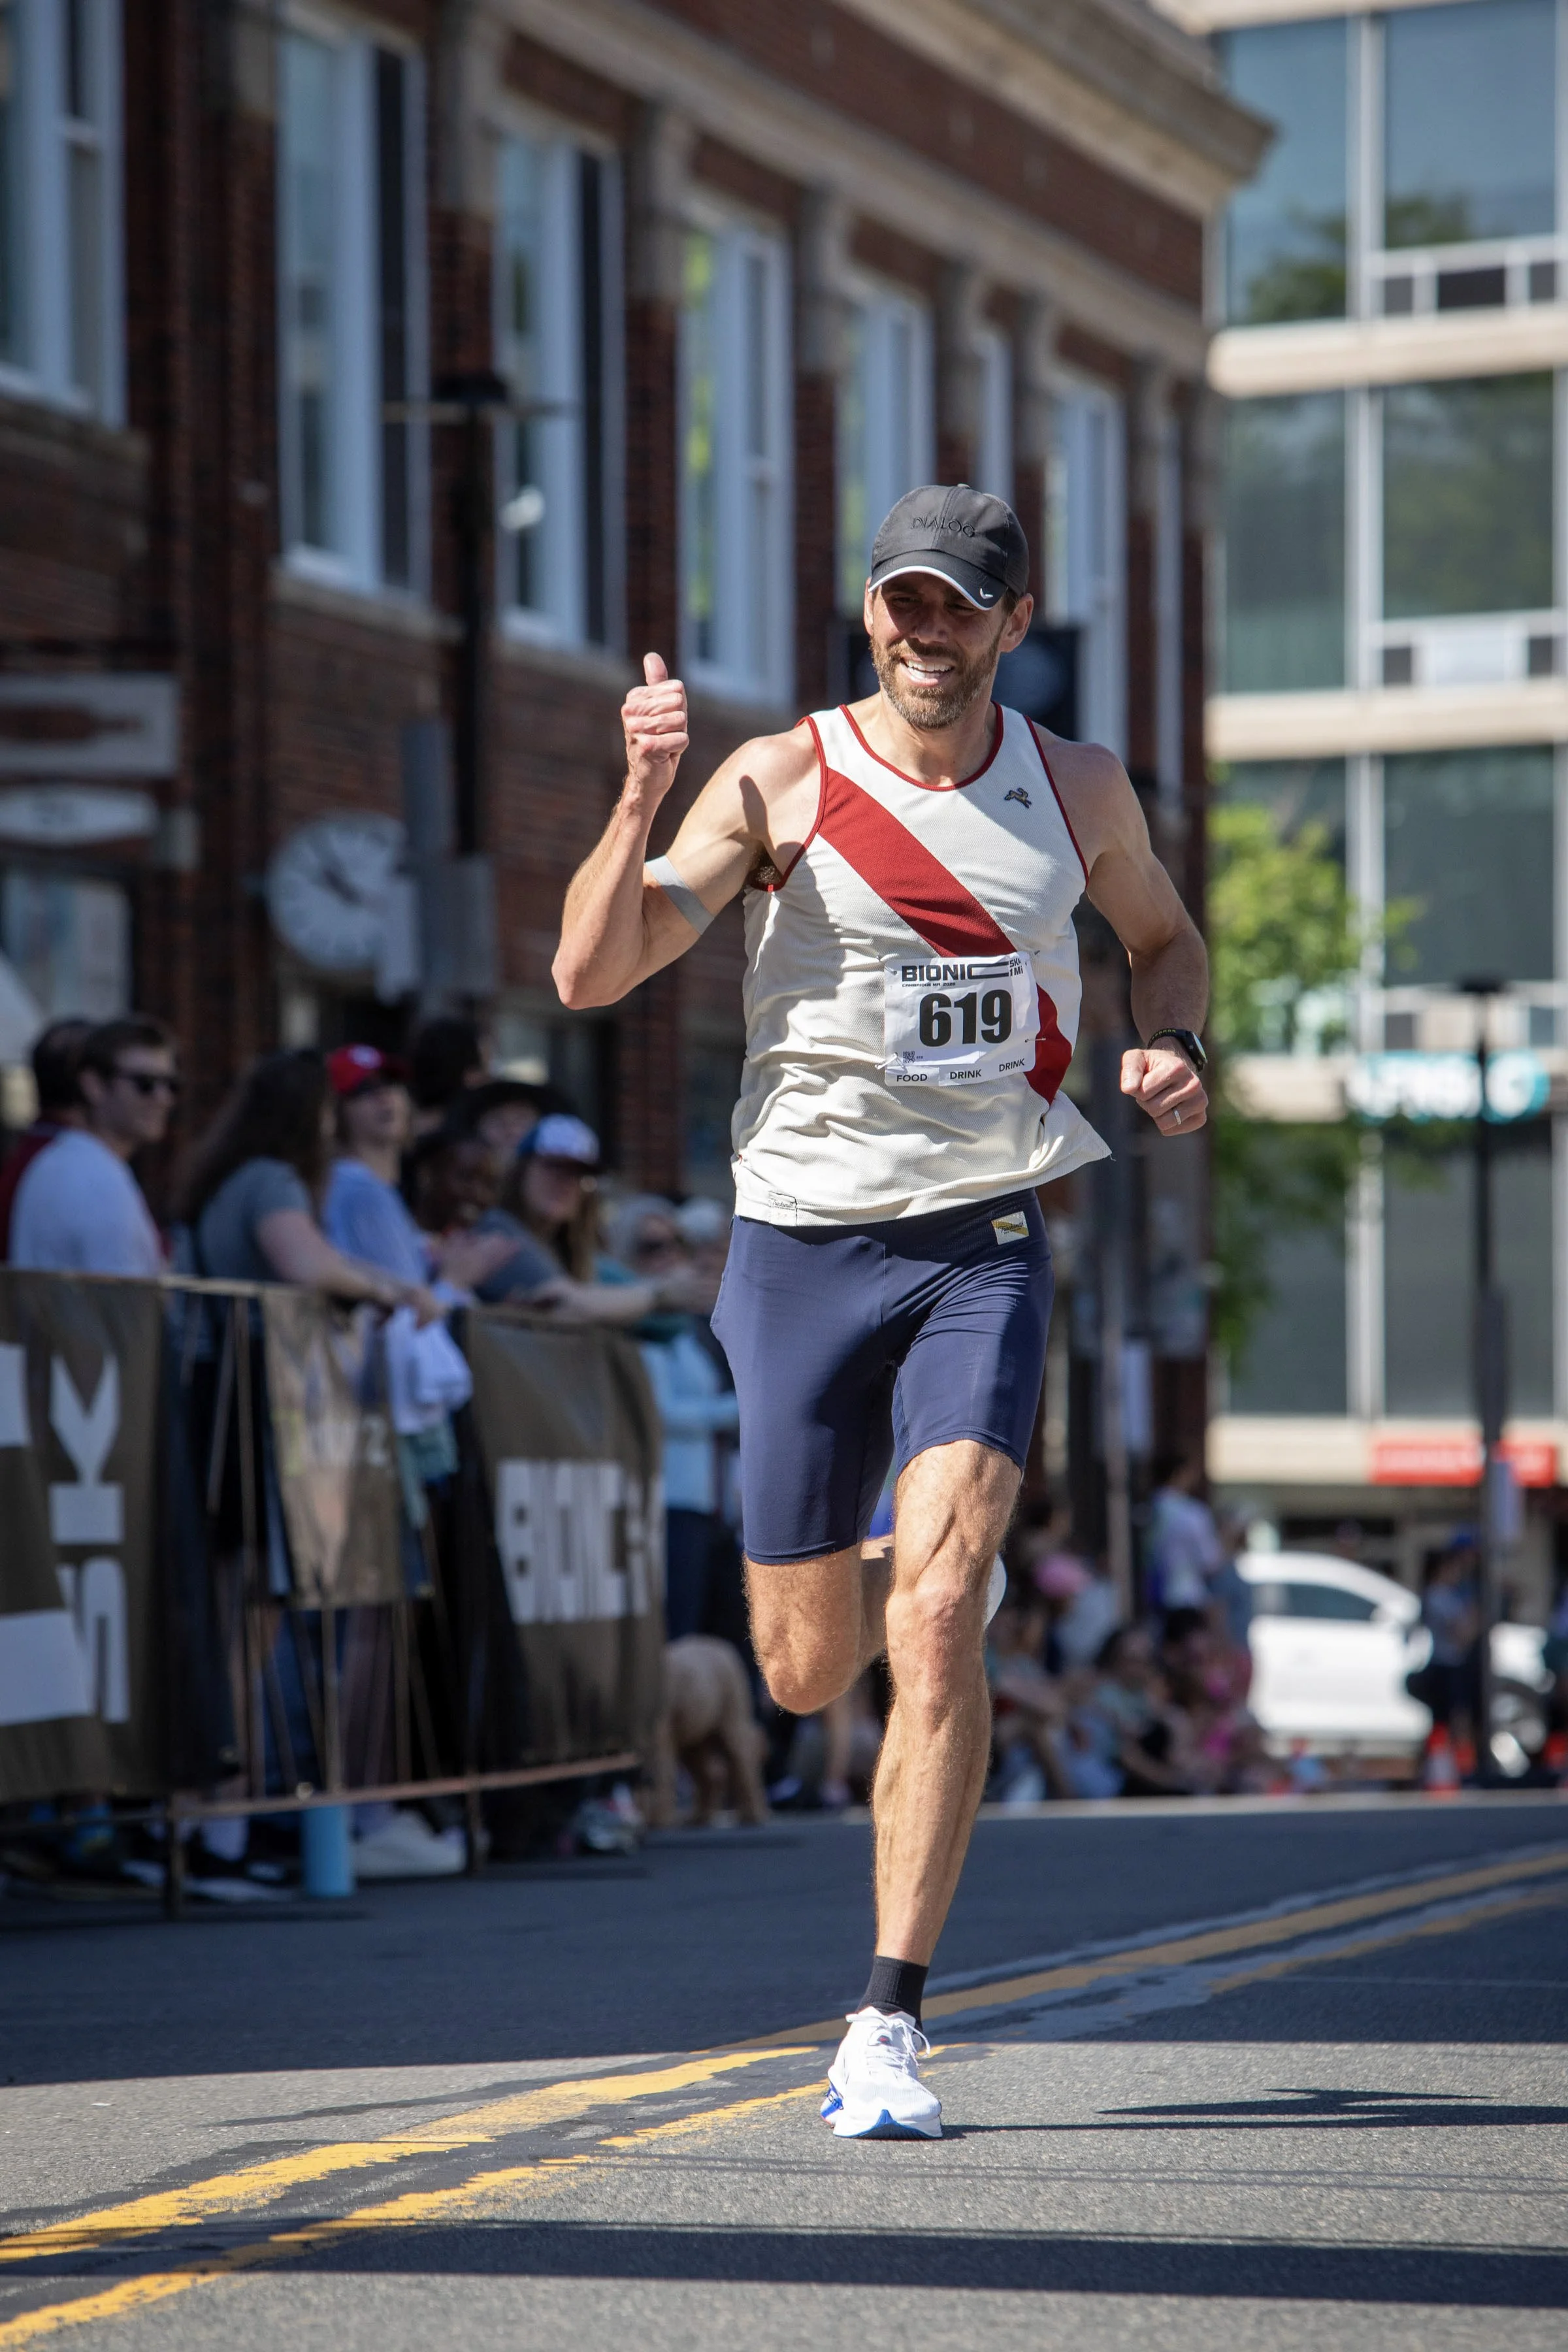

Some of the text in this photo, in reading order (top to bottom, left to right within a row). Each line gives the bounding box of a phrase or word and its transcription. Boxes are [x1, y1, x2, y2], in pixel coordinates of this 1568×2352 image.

[911, 516, 975, 538] DIALOG
[902, 960, 1009, 982] BIONIC
[919, 989, 1012, 1047] 619
[896, 1058, 1025, 1083] FOOD DRINK DRINK
